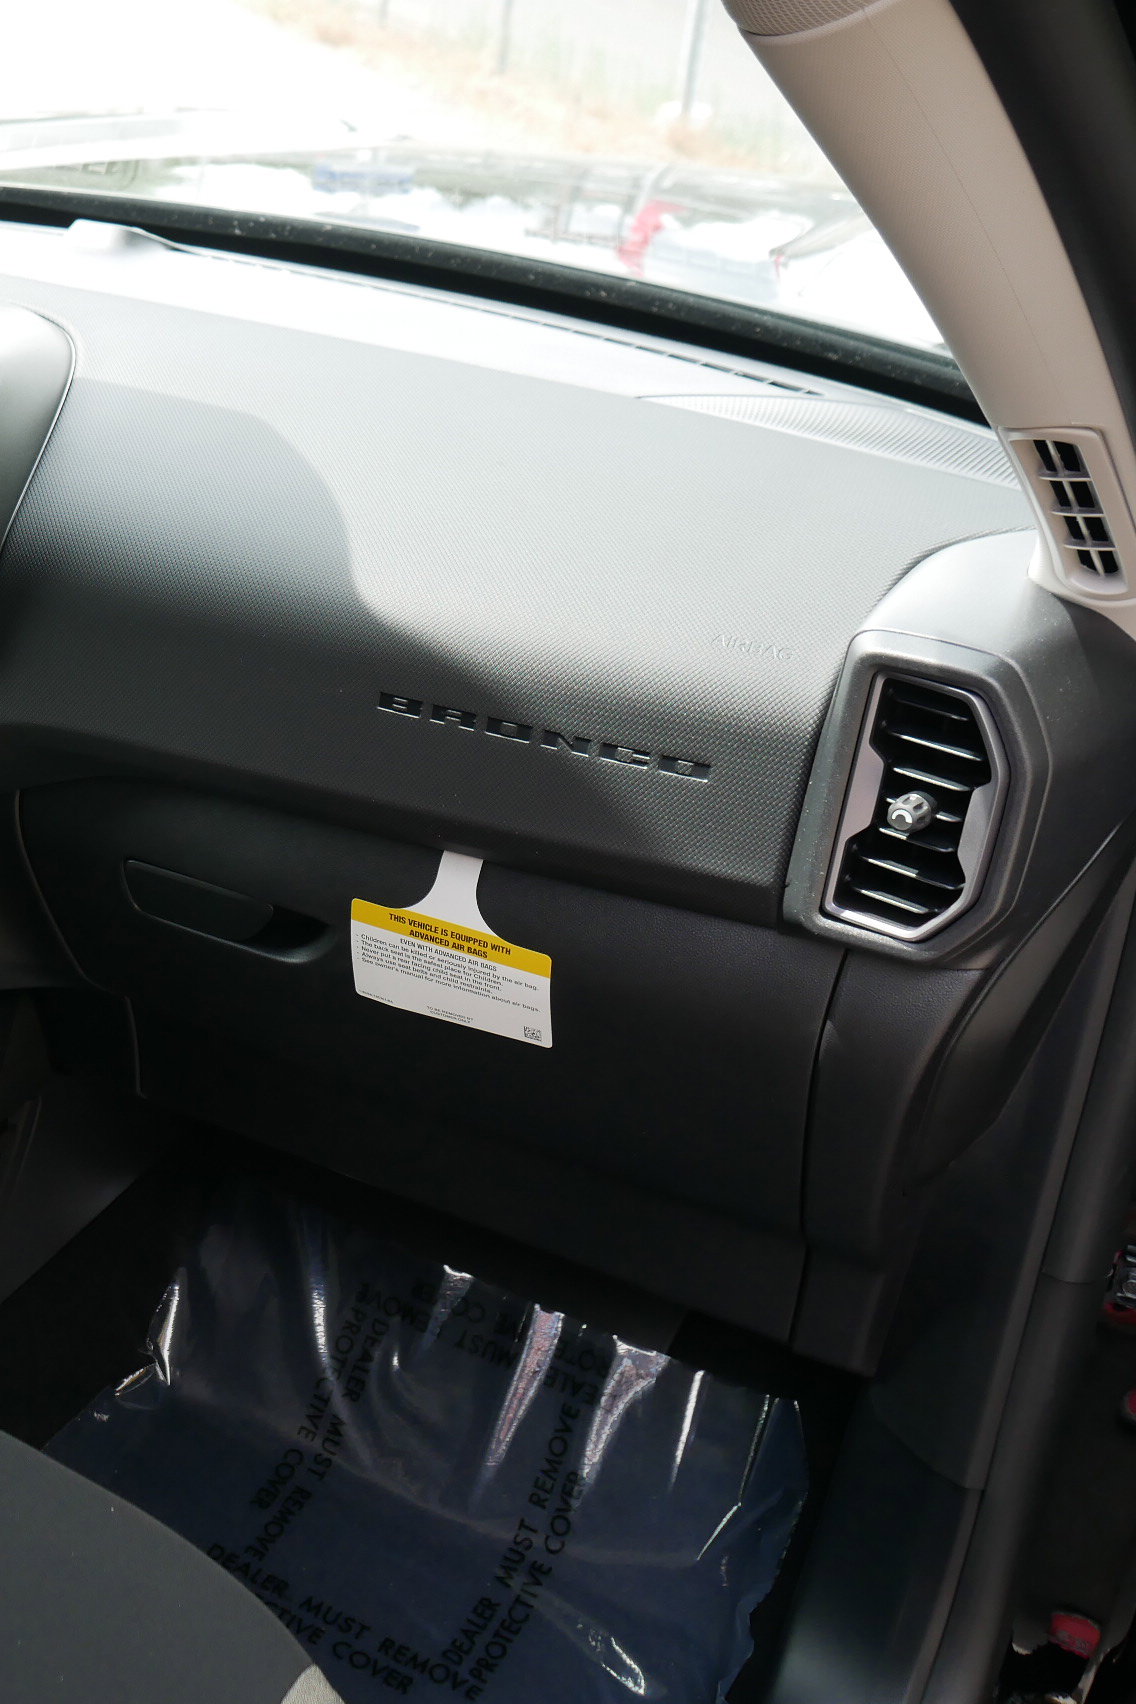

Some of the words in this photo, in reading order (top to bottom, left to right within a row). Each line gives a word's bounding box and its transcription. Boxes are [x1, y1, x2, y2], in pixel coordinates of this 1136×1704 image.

[710, 633, 794, 661] AIRBAG
[376, 690, 712, 783] BRONCO
[361, 940, 373, 948] The
[374, 944, 389, 952] back
[390, 949, 404, 957] seat
[412, 954, 422, 962] the
[424, 959, 443, 968] safest
[444, 965, 462, 974] place
[361, 933, 387, 946] Children
[410, 948, 428, 959] killed
[437, 957, 467, 970] seriously
[468, 965, 491, 977] injured
[492, 972, 500, 981] by
[502, 975, 513, 983] the
[389, 912, 406, 924] THIS
[408, 918, 439, 934] VEHICLE
[441, 928, 449, 937] IS
[451, 930, 489, 949] EQUIPPED
[491, 943, 511, 955] WITH
[400, 938, 416, 948] EVEN
[417, 943, 433, 953] WITH
[434, 948, 467, 963] ADVANCED
[468, 959, 479, 967] AIR
[480, 962, 497, 972] BAGS
[409, 929, 450, 947] ADVANCED
[452, 942, 465, 952] AIR
[467, 946, 488, 959] BAGS
[361, 945, 379, 955] Never
[397, 957, 410, 965] rear
[411, 960, 431, 971] facing
[432, 966, 448, 976] child
[449, 971, 463, 980] seat
[472, 978, 483, 986] the
[362, 951, 383, 963] Always
[398, 962, 411, 971] seat
[429, 971, 441, 979] and
[443, 975, 459, 985] child
[362, 957, 374, 965] See
[375, 961, 399, 973] owner's
[400, 969, 424, 980] manual
[435, 979, 452, 988] more
[453, 983, 491, 999] information
[492, 995, 511, 1005] about
[342, 1317, 390, 1402] DEALER
[307, 1413, 346, 1482] MUST
[249, 1448, 305, 1510] COVER
[244, 1484, 313, 1562] REMOVE
[441, 1596, 501, 1666] DEALER
[494, 1518, 539, 1589] MUST
[527, 1401, 581, 1510] REMOVE
[206, 1543, 290, 1599] DEALER
[298, 1595, 372, 1640] MUST
[377, 1636, 486, 1701] REMOVE
[468, 1560, 553, 1685] PROTECTIVE
[331, 1640, 414, 1696] COVER
